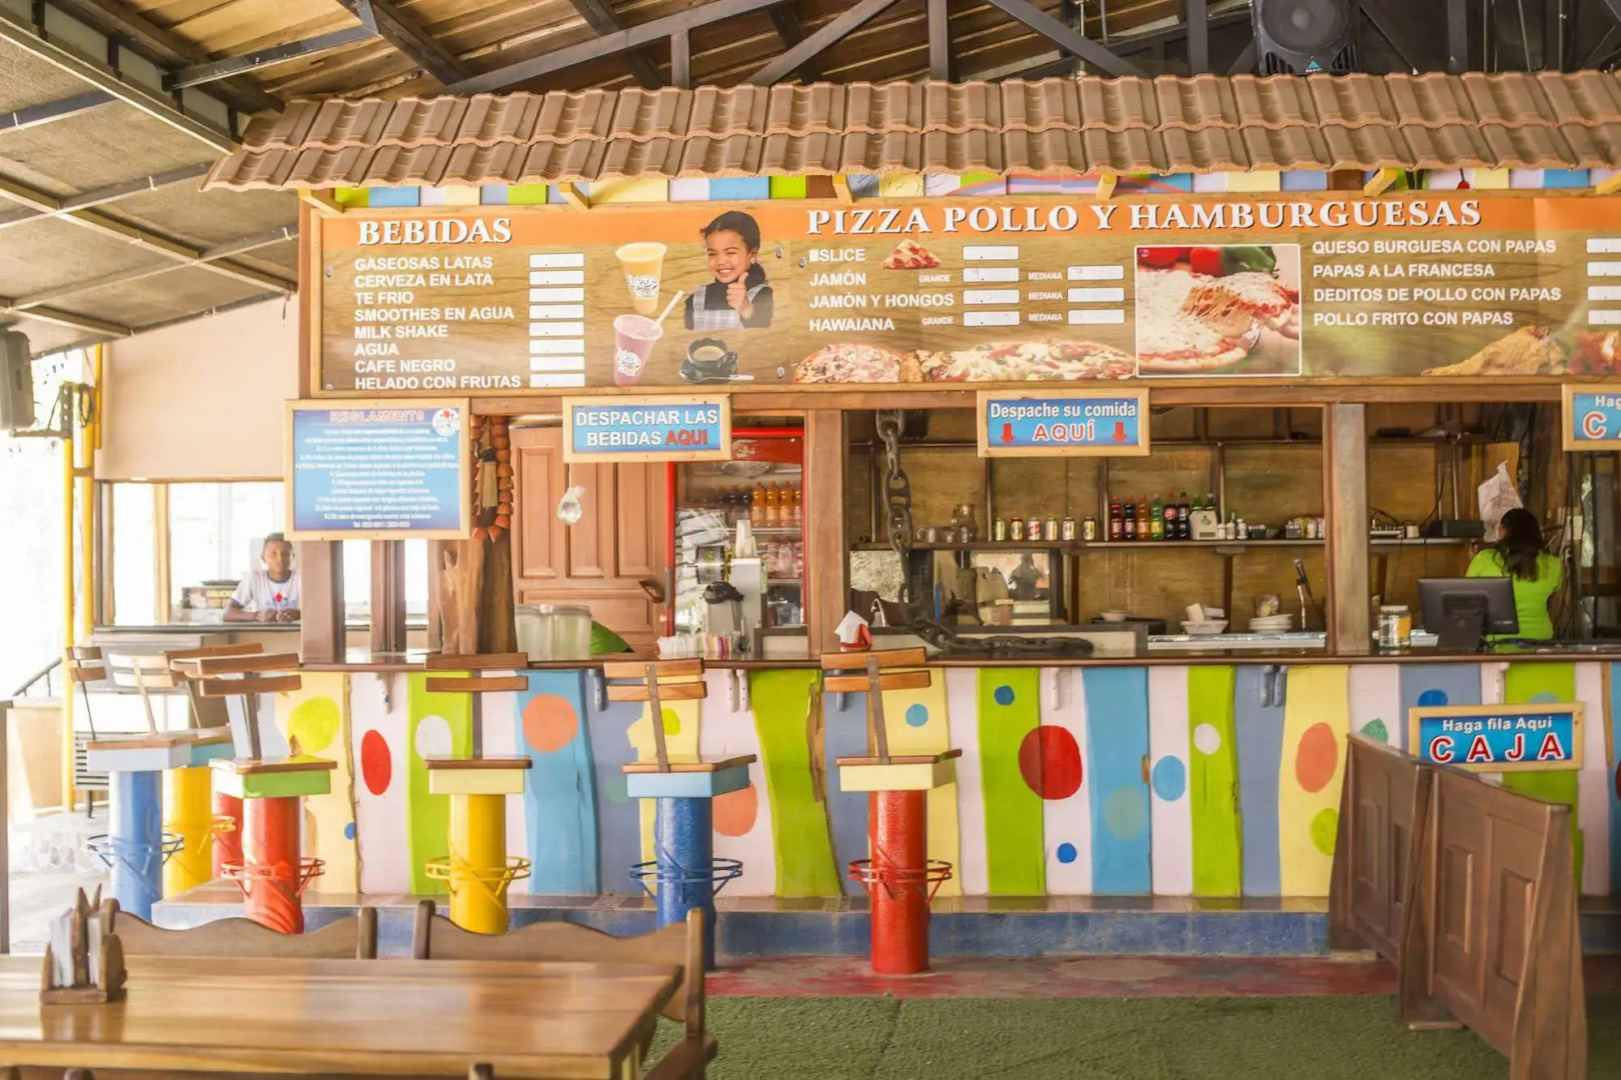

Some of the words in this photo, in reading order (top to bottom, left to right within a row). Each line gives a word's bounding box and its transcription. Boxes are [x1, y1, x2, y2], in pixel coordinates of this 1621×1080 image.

[806, 209, 931, 234] PIZZA
[944, 205, 1079, 232] POLLO
[1090, 205, 1116, 229] Y
[1128, 200, 1481, 230] HAMBURGUESAS
[358, 218, 512, 245] BEBIDAS
[1312, 240, 1370, 255] QUESO
[1374, 240, 1463, 254] BURGUESA
[1467, 239, 1501, 253] CON
[1506, 239, 1555, 253] PAPAS
[819, 249, 865, 261] SLICE
[355, 257, 440, 271] GASEOSAS
[444, 256, 492, 269] LATAS
[810, 270, 866, 286] JAMÓN
[1028, 272, 1062, 280] MEDIANA
[1313, 264, 1364, 278] PAPAS
[1367, 264, 1380, 277] A
[1383, 264, 1404, 277] LA
[1408, 264, 1494, 277] FRANCESA
[355, 274, 425, 287] CERVEZA
[430, 274, 450, 286] EN
[454, 274, 493, 285] LATA
[355, 292, 373, 304] TE
[378, 291, 414, 304] FRIO
[810, 293, 866, 308] JAMÓN
[870, 295, 879, 306] Y
[886, 293, 954, 307] HONGOS
[1028, 292, 1063, 300] MEDIANA
[1314, 288, 1382, 303] DEDITOS
[1388, 289, 1410, 301] DE
[1414, 287, 1464, 301] POLLO
[1468, 287, 1505, 301] CON
[1511, 286, 1561, 301] PAPAS
[355, 308, 440, 322] SMOOTHES
[445, 308, 465, 320] EN
[469, 306, 514, 320] AGUA
[1028, 313, 1062, 322] MEDIANA
[1314, 312, 1367, 325] POLLO
[1373, 312, 1420, 325] FRITO
[1424, 311, 1458, 325] CON
[1463, 311, 1513, 325] PAPAS
[810, 318, 895, 331] HAWAIANA
[922, 317, 954, 326] GRANDE
[355, 326, 390, 339] MILK
[395, 325, 448, 338] SHAKE
[355, 343, 399, 356] AGUA
[355, 361, 395, 373] CAFE
[400, 359, 455, 372] NEGRO
[356, 376, 418, 390] HELADO
[423, 376, 456, 389] CON
[461, 376, 521, 388] FRUTAS
[576, 411, 679, 426] DESPACHAR
[685, 410, 717, 424] LAS
[991, 403, 1059, 420] Despache
[1064, 406, 1080, 417] su
[1085, 402, 1136, 417] comida
[587, 431, 661, 446] BEBIDAS
[665, 429, 708, 445] AQUI
[1032, 419, 1096, 442] AQUÍ
[1443, 720, 1482, 733] Haga
[1488, 719, 1511, 730] fila
[1430, 732, 1565, 763] CAJA
